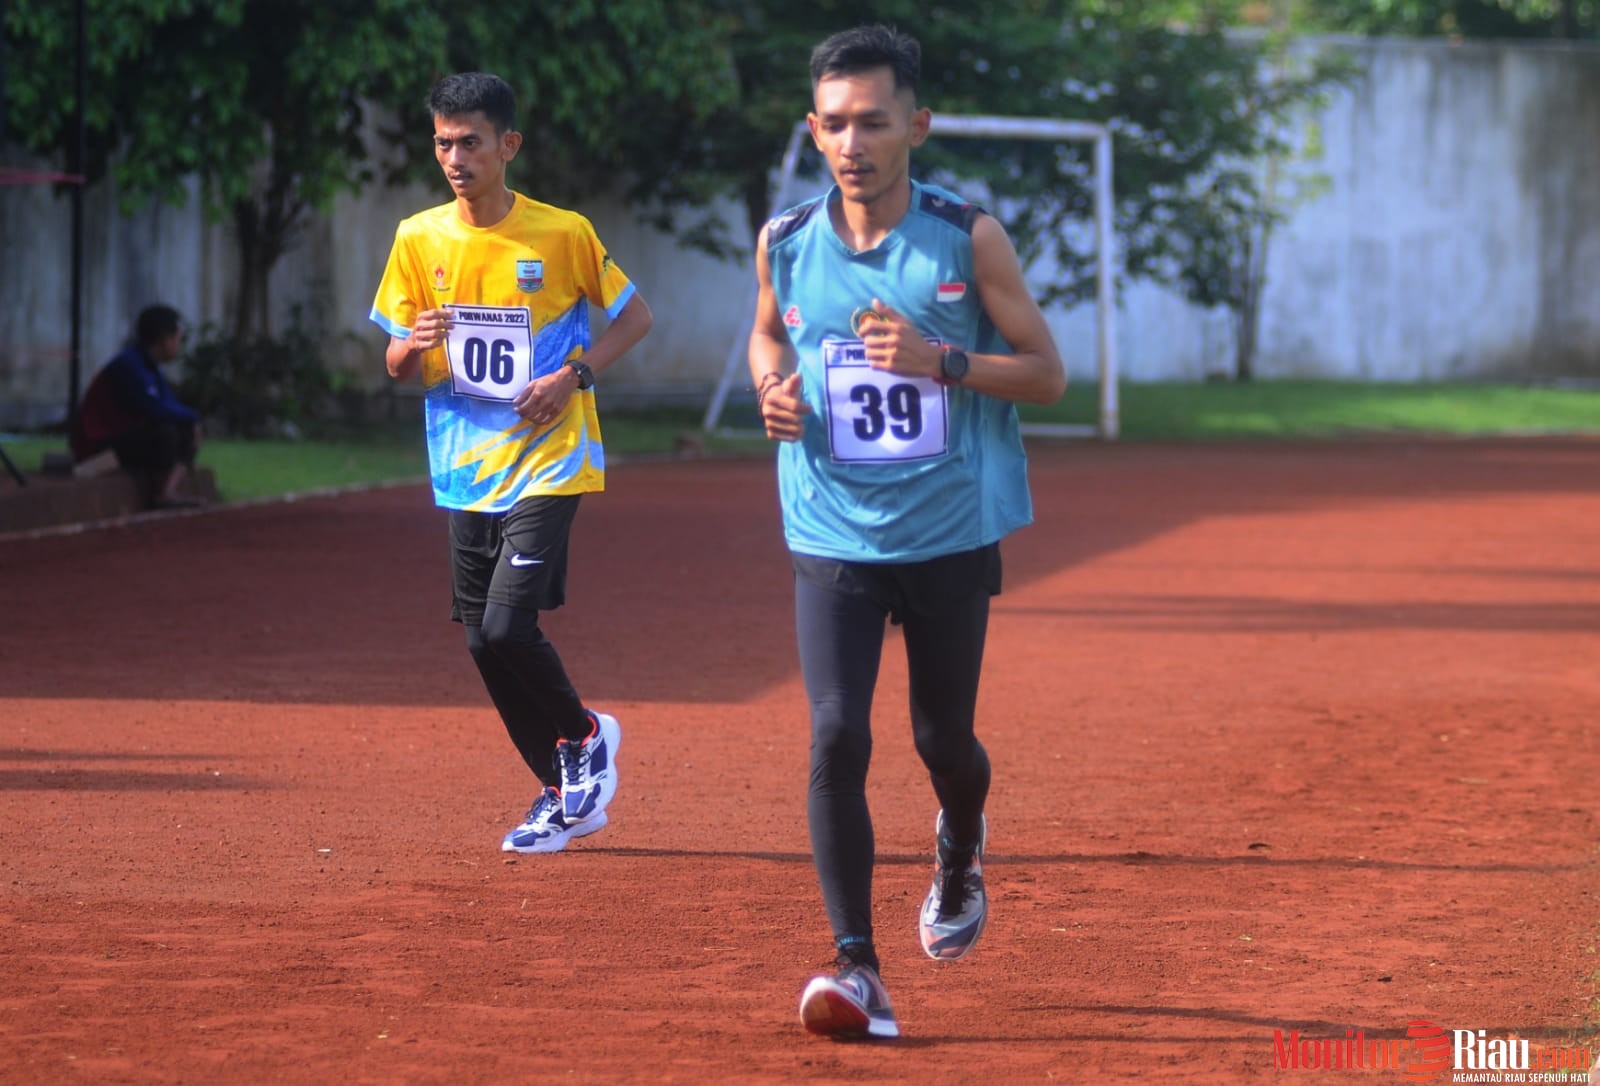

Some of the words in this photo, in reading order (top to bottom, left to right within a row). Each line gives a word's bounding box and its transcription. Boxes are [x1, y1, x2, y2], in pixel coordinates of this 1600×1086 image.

[504, 313, 525, 324] 2022
[463, 337, 515, 385] 06
[850, 383, 923, 442] 39
